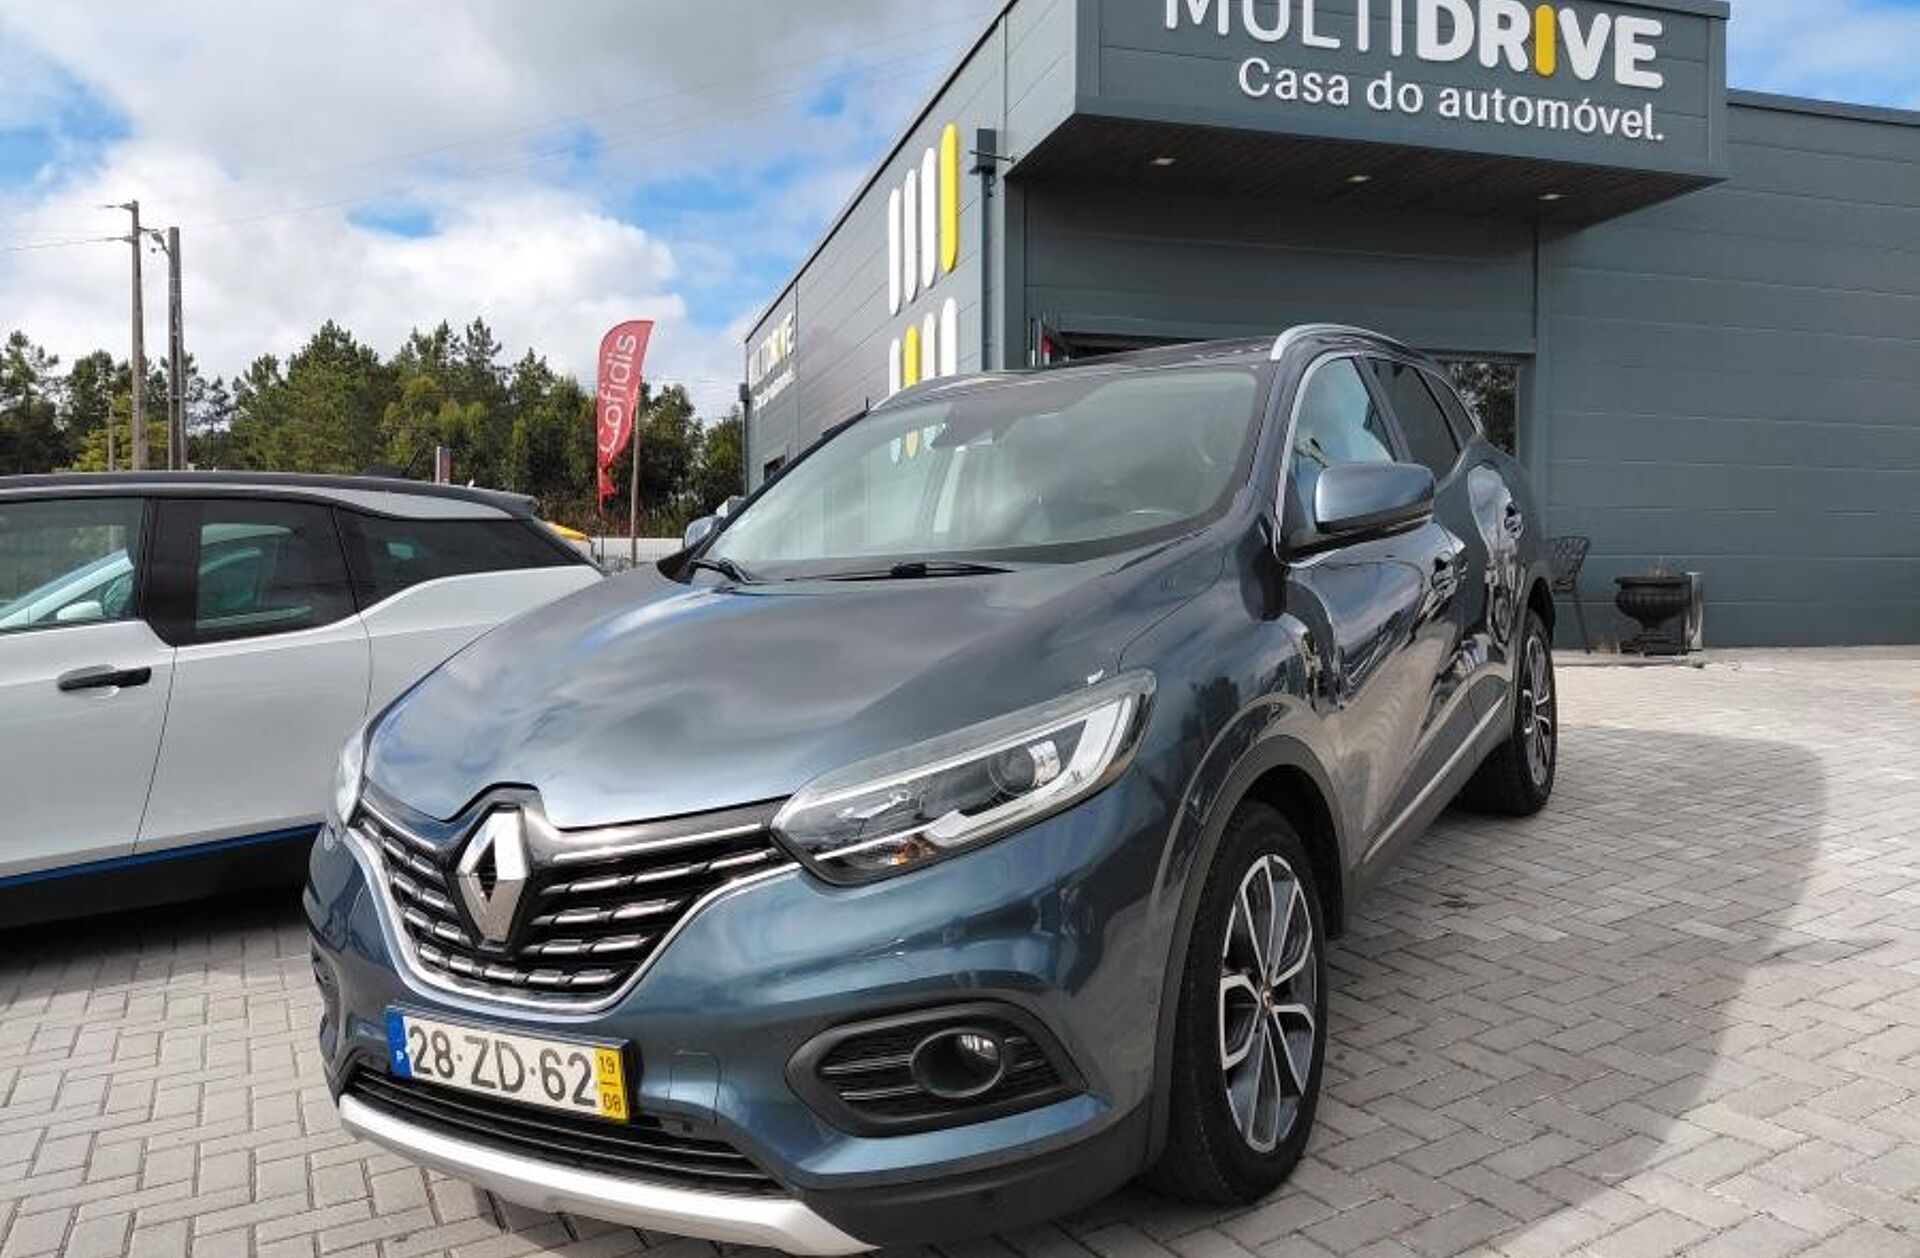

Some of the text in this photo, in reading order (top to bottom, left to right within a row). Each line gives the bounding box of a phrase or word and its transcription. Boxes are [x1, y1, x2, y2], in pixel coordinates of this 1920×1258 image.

[1238, 56, 1665, 141] Casa do automóvel.
